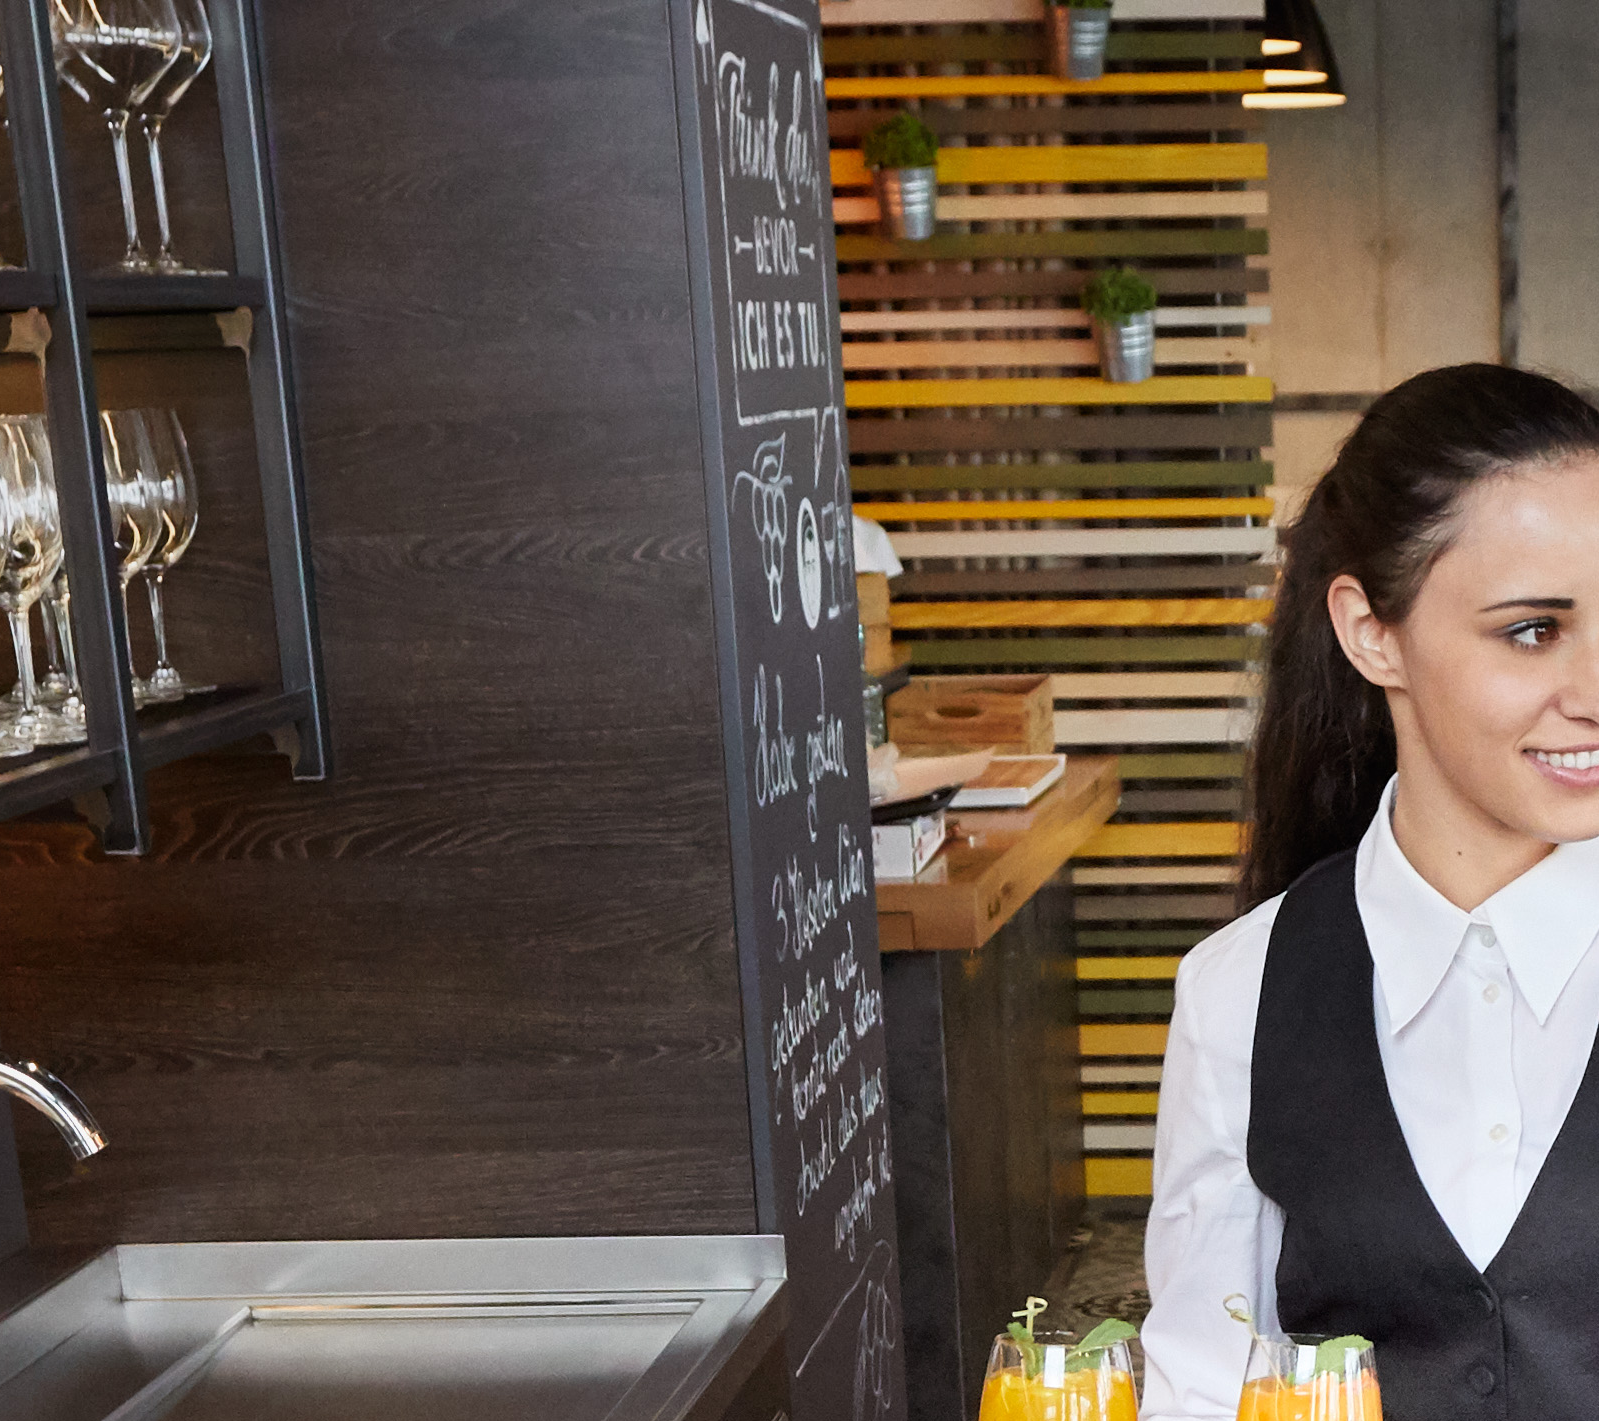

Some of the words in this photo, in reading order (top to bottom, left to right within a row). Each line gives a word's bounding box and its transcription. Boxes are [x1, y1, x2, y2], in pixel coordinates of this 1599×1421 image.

[753, 215, 800, 276] BEVOR
[737, 299, 771, 373] ICH
[774, 300, 795, 370] ES
[771, 872, 789, 964] 3
[833, 919, 859, 993] und
